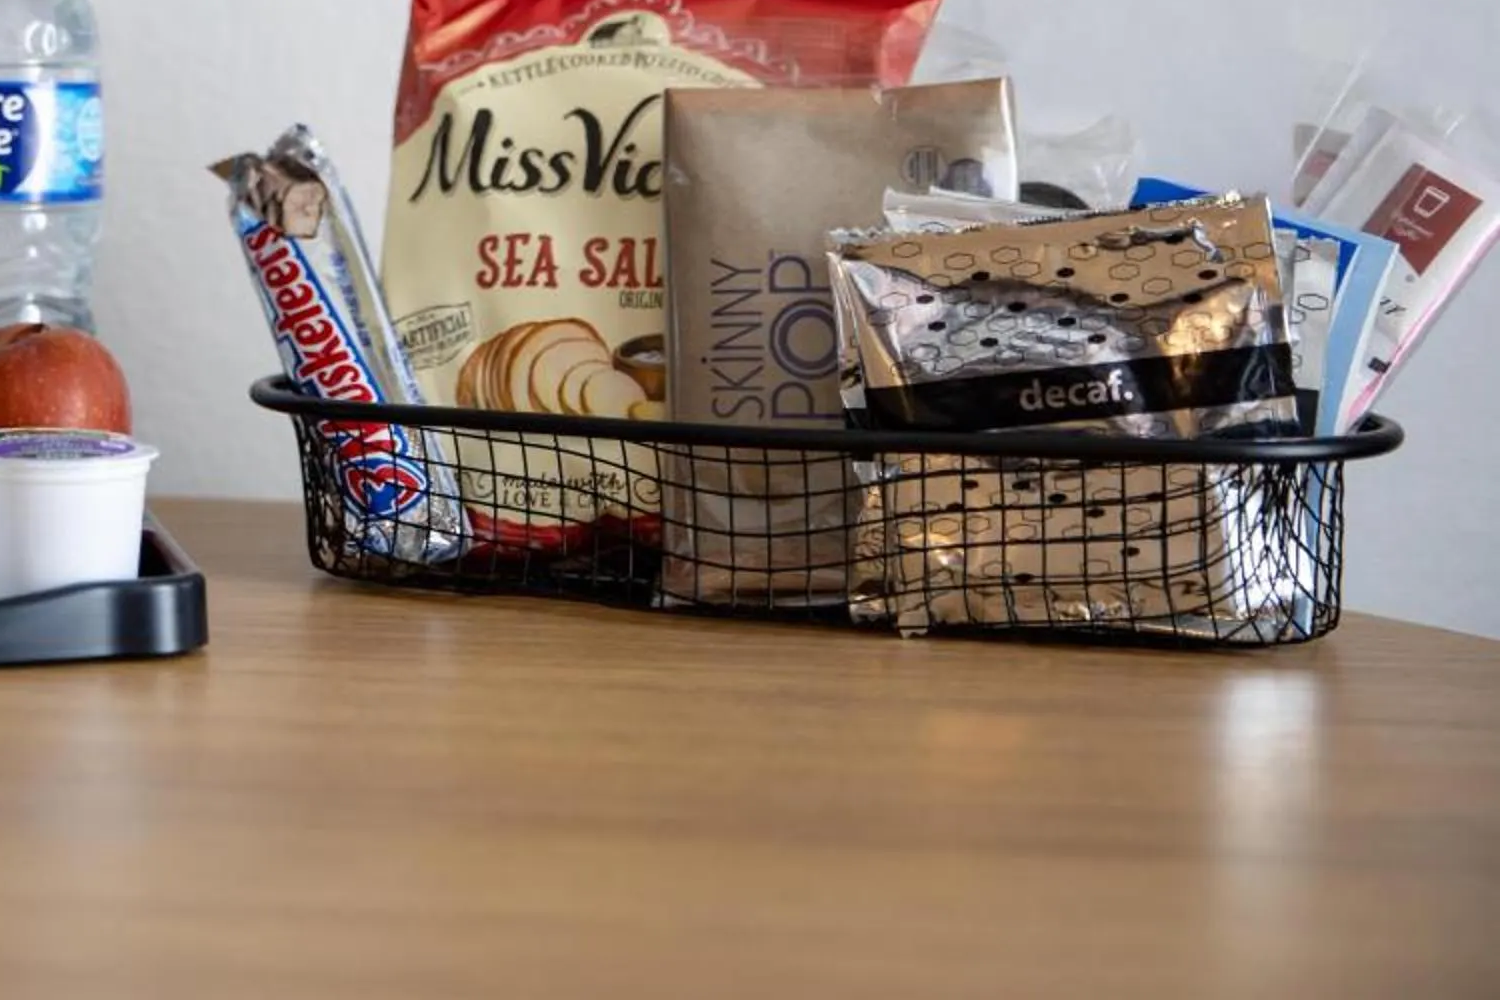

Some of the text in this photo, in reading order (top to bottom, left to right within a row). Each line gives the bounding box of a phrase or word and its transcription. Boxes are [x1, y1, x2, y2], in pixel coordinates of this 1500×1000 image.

[488, 55, 560, 89] KETTLE
[409, 93, 663, 203] Miss Vic
[476, 233, 664, 289] SEA SAL
[619, 290, 663, 309] ORIGIN
[701, 258, 765, 420] SKINNY
[769, 255, 846, 420] POP
